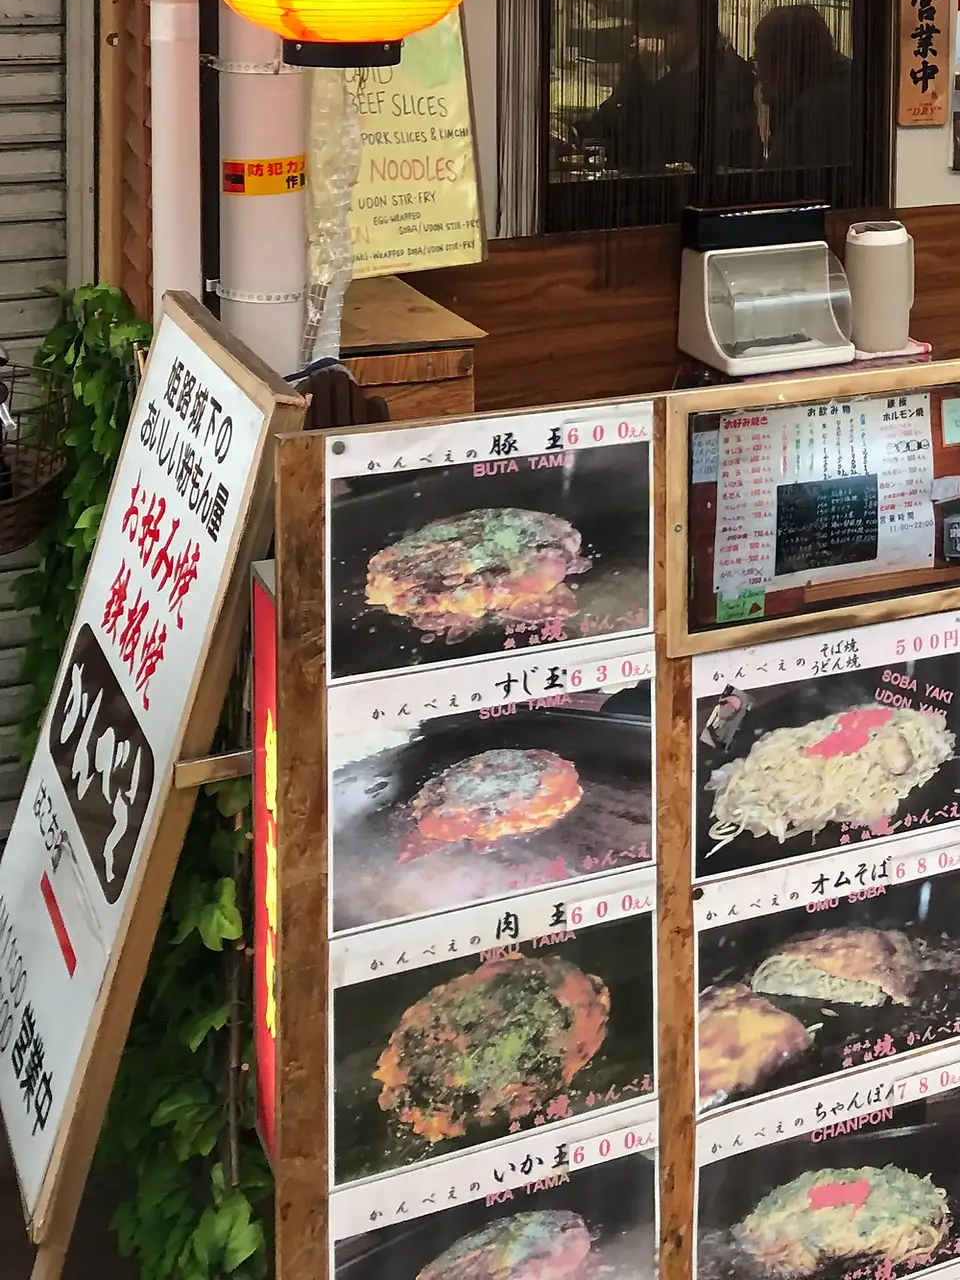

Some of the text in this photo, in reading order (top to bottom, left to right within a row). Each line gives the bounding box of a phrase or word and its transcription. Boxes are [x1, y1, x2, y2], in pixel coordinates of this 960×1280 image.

[392, 94, 447, 118] SLICES
[361, 130, 392, 146] PORK
[394, 131, 427, 145] SLICES
[431, 127, 438, 141] &
[370, 156, 458, 183] NOODLES
[358, 195, 387, 210] UDON
[392, 191, 436, 206] STIR-FRY
[163, 355, 235, 466] 姫路城下の
[807, 404, 850, 417] お飲み物
[882, 407, 924, 421] ホルモン焼
[367, 448, 478, 471] かんべえの
[567, 422, 648, 446] 600えん
[140, 400, 231, 542] おいしい粉もん屋
[473, 454, 574, 478] BUTA TAMA
[880, 512, 915, 524] 営業時間
[121, 468, 201, 630] お好み焼
[101, 557, 168, 712] 鉄板焼
[712, 629, 959, 680] かんべえの そば焼 500円
[812, 655, 861, 676] うどん焼
[372, 660, 653, 721] かんべえの すじ玉 630えん
[875, 687, 913, 708] UDON
[881, 669, 954, 704] SOBA YAKI
[479, 693, 573, 720] SUJI TAMA
[62, 662, 142, 884] かんべえ
[904, 802, 960, 827] かんべえ
[706, 891, 799, 921] かんべえの
[811, 856, 892, 895] オムそば
[805, 884, 886, 914] OMU SOBA
[370, 934, 481, 971] かんべえの
[571, 895, 652, 925] 600えん
[479, 929, 577, 963] NIKU TAMA
[11, 999, 53, 1137] 営業中
[711, 1117, 804, 1153] かんべえの
[811, 1108, 894, 1143] CHANPON
[370, 1181, 481, 1221] かんべえの
[573, 1131, 655, 1164] 600えん
[485, 1173, 571, 1207] IKA TAMA
